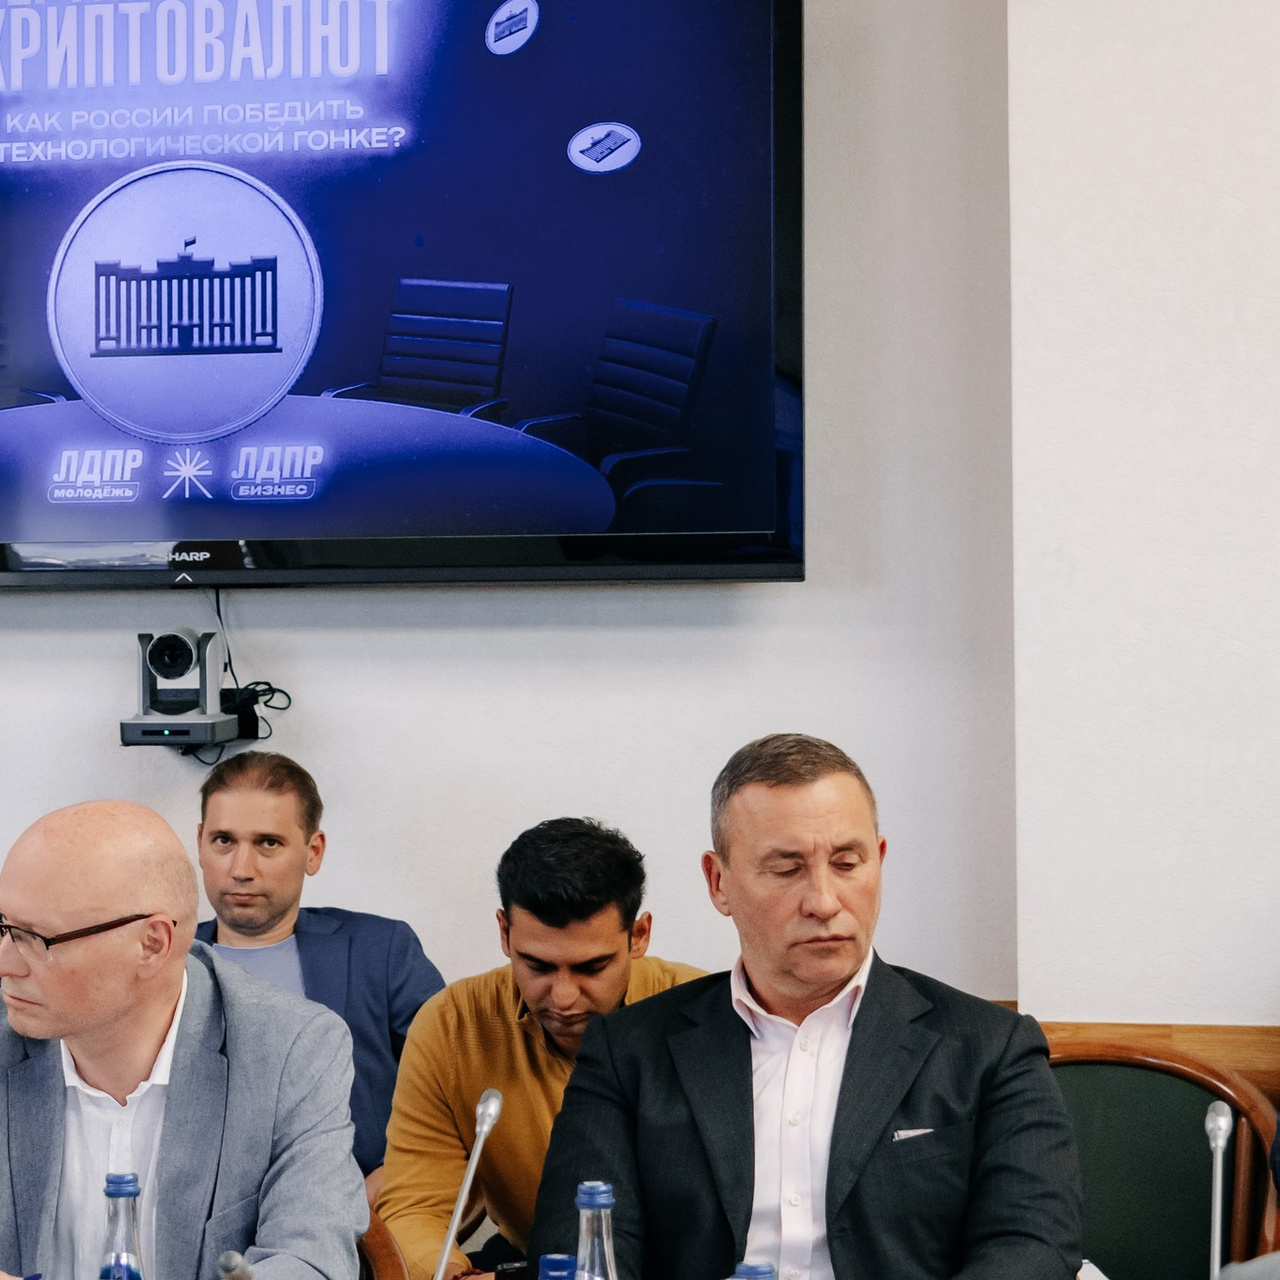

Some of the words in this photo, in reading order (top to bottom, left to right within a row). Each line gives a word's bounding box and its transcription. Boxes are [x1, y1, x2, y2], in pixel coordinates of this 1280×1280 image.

[6, 111, 64, 134] КАК
[71, 106, 194, 130] РОССИИ
[203, 99, 365, 126] ПОБЕДИТЬ
[293, 126, 406, 152] ГОНКЕ?
[52, 449, 143, 487] ЛДПР
[231, 445, 324, 484] ЛДПР
[53, 486, 134, 499] МОЛОДЁЖЬ
[238, 484, 308, 496] БИЗНЕС
